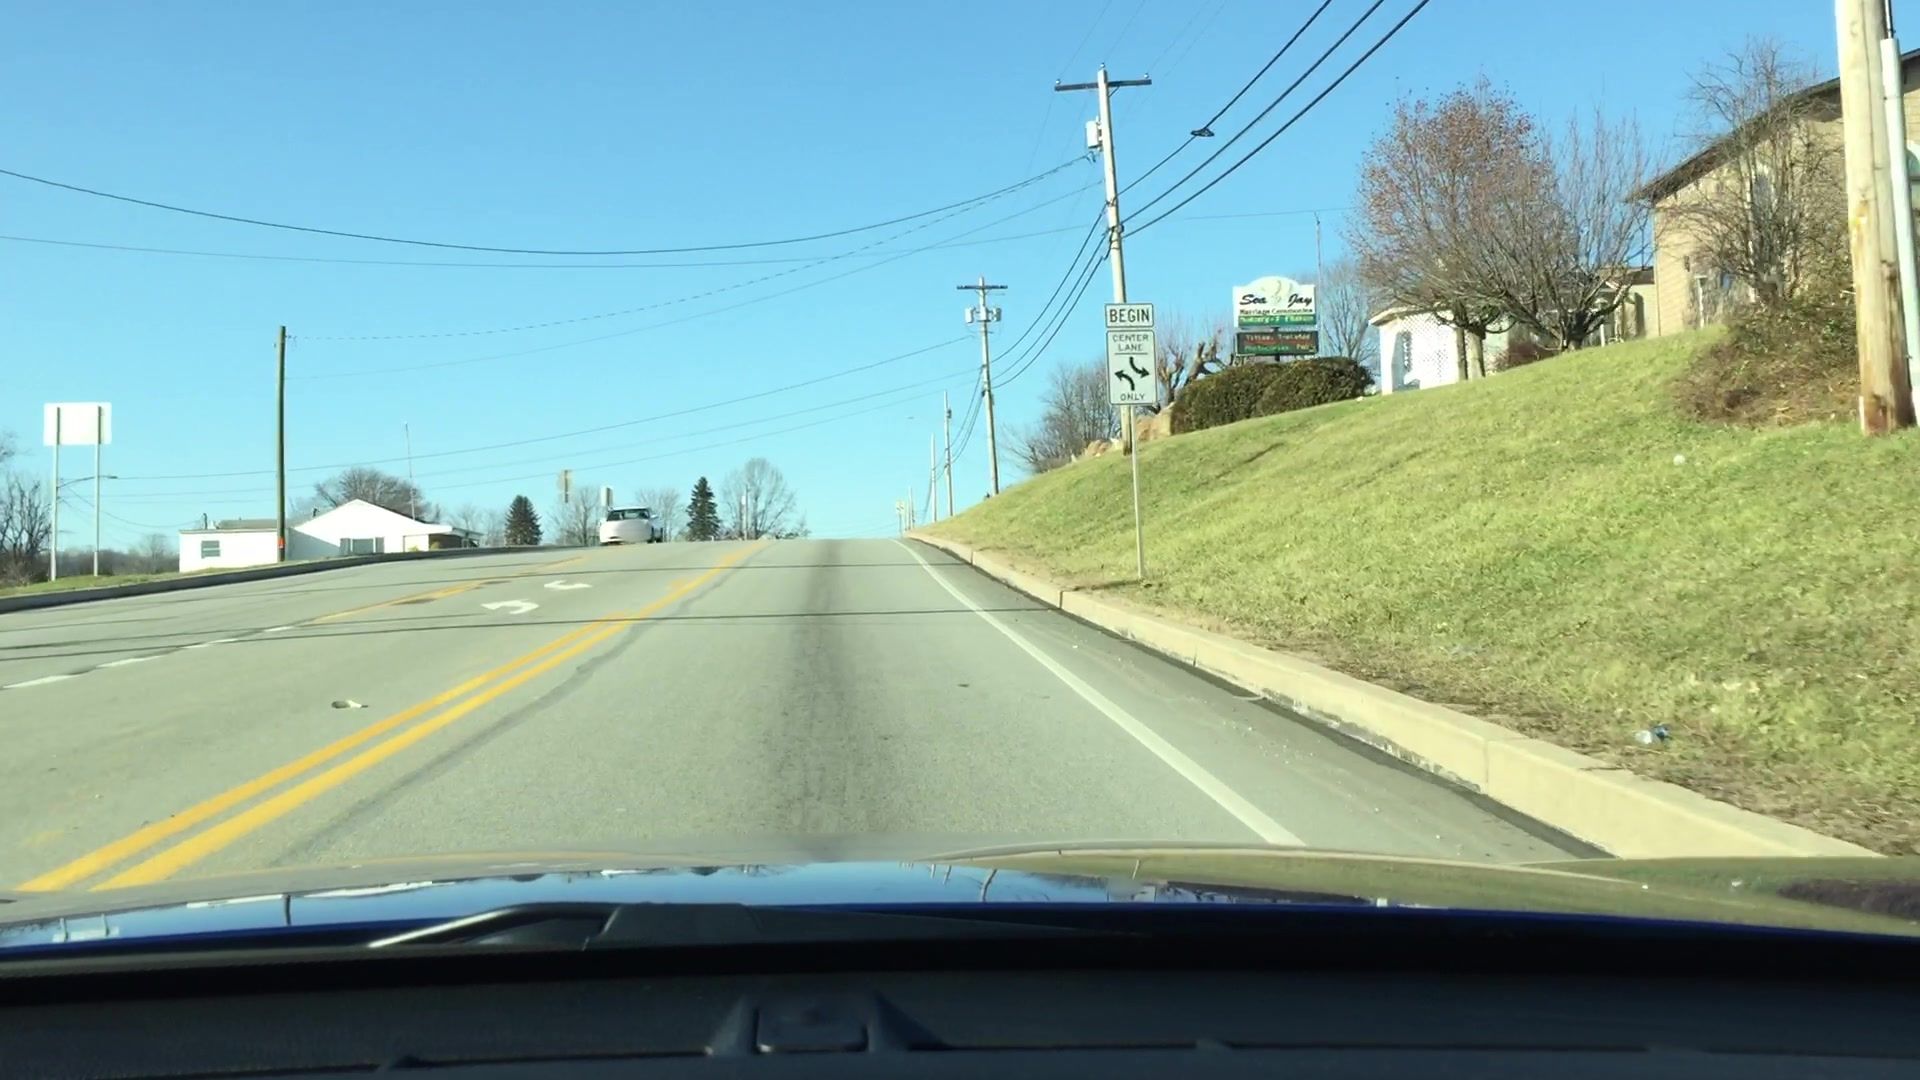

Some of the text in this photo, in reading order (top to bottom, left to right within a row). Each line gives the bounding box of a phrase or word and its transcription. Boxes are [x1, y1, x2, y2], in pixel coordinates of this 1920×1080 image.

[1287, 293, 1313, 308] Jay
[1109, 308, 1150, 323] BEGIN
[1112, 333, 1149, 342] CENTER
[1118, 343, 1144, 352] LANE
[1120, 392, 1145, 401] ONLY
